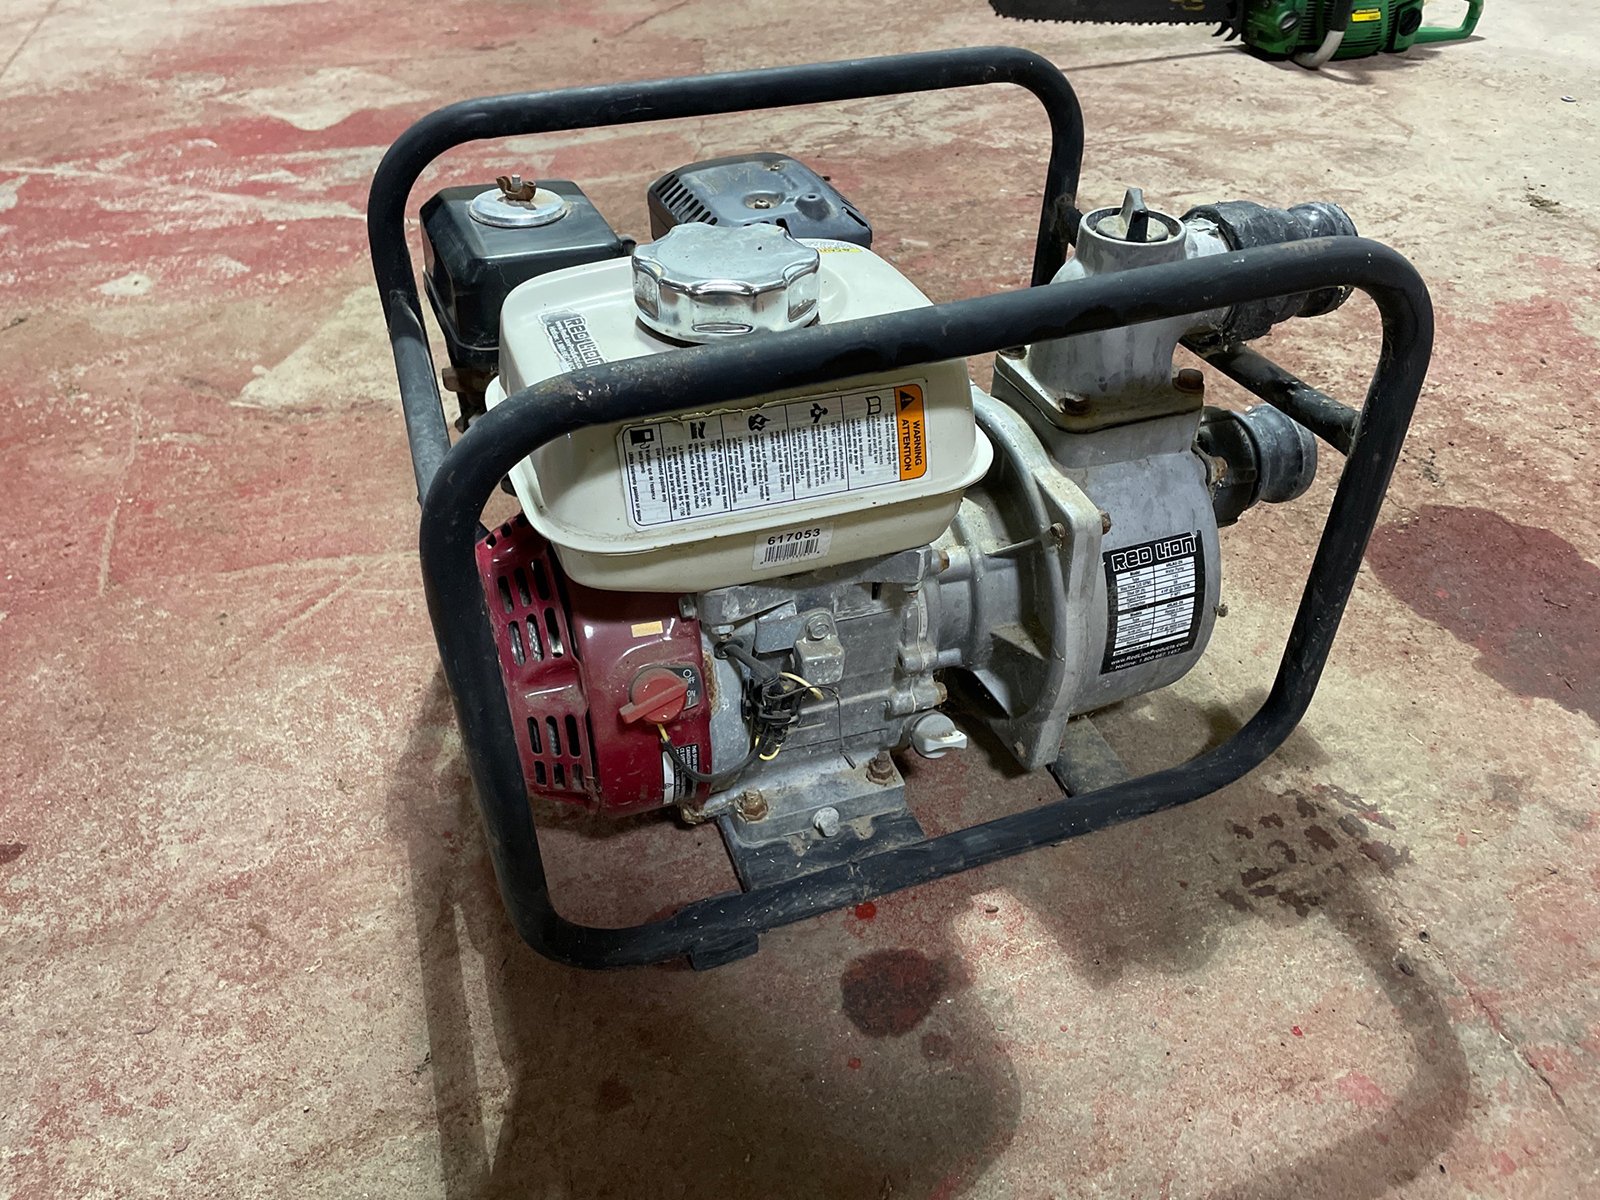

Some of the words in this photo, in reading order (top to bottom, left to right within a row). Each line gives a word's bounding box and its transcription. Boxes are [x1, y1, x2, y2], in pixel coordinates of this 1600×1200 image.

[900, 418, 912, 471] ATTENTION
[912, 420, 922, 466] WARNING
[768, 528, 820, 546] 617053
